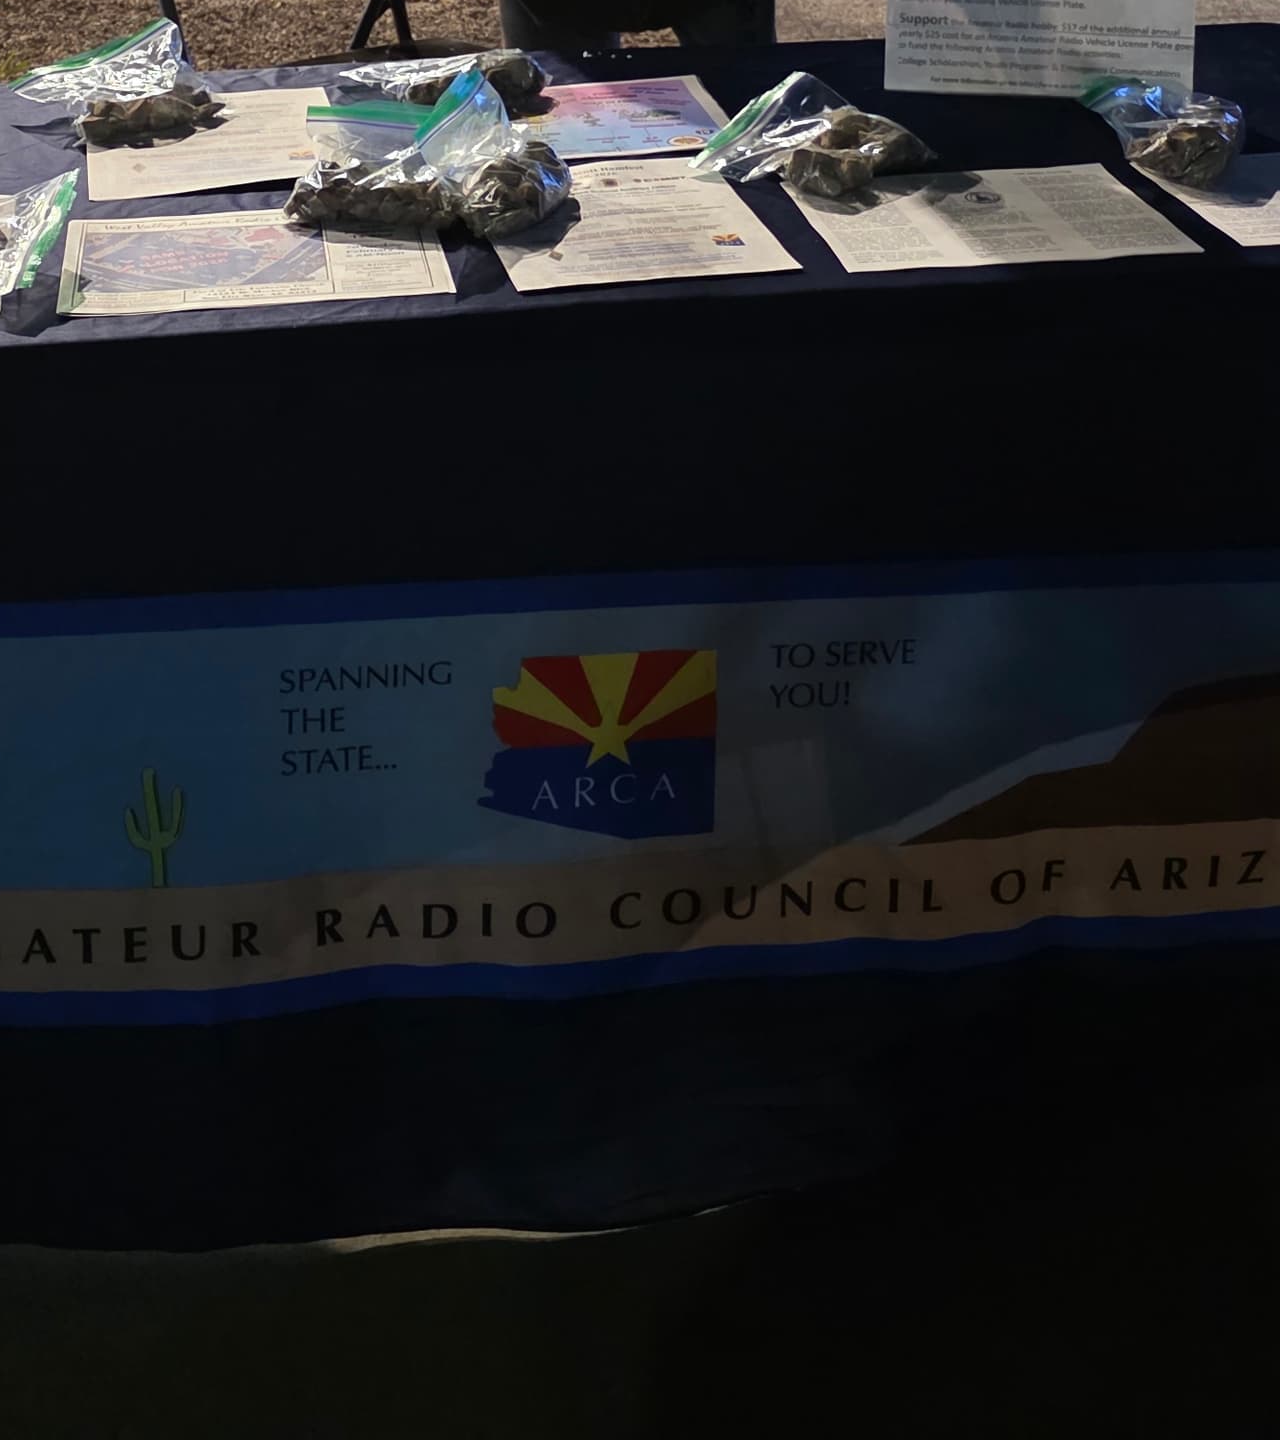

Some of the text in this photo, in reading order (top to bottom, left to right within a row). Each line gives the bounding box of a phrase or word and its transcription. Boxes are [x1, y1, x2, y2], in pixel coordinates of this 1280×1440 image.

[899, 12, 949, 27] Support
[1079, 24, 1088, 32] of
[1090, 25, 1104, 33] the
[1107, 26, 1149, 34] additional
[1151, 27, 1180, 36] annual
[908, 41, 927, 50] fund
[930, 42, 942, 50] the
[1059, 36, 1084, 45] Radio
[1086, 38, 1115, 47] Vehicle
[1118, 40, 1148, 48] License
[1151, 41, 1172, 50] Plate
[769, 639, 918, 670] TO SERVE
[278, 660, 453, 695] SPANNING
[768, 681, 851, 710] YOU!
[280, 707, 346, 736] THE
[279, 744, 399, 777] STATE...
[530, 771, 677, 812] ARCA
[314, 901, 558, 947] RADIO
[609, 877, 944, 930] COUNCIL
[989, 858, 1067, 906] OF
